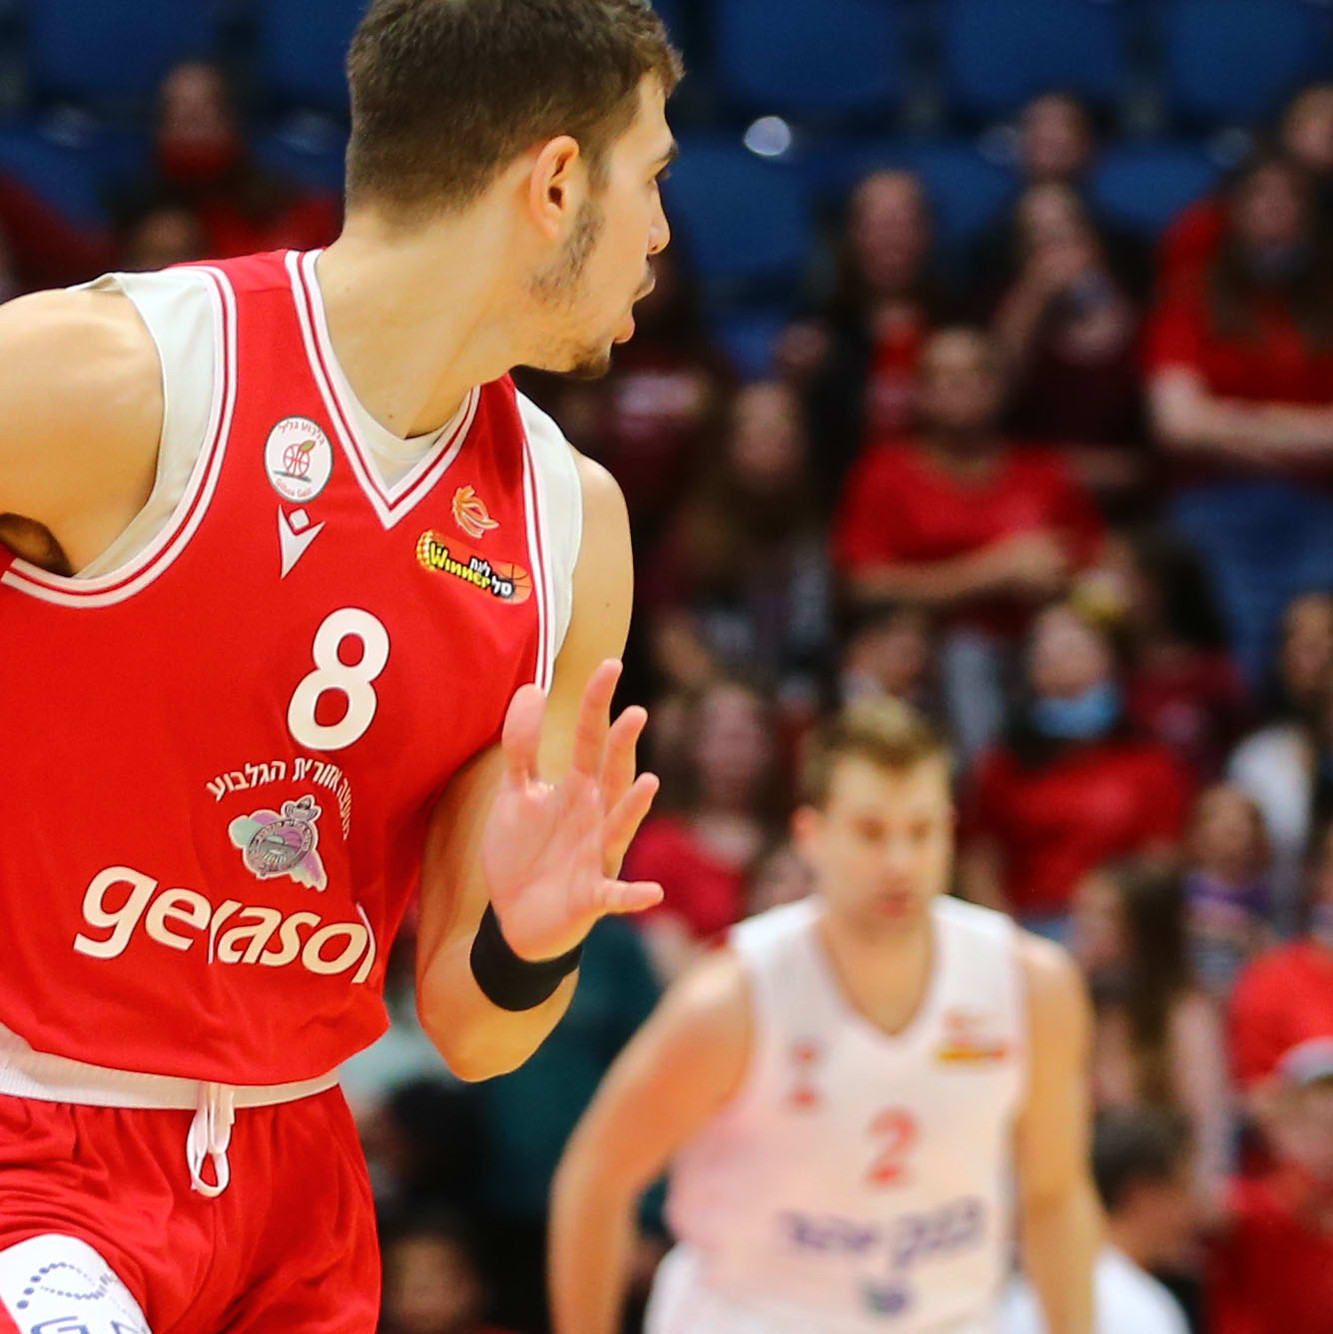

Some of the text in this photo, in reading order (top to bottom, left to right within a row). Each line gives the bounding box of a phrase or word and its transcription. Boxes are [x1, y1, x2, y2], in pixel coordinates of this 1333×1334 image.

[429, 541, 491, 589] Winner
[287, 606, 390, 750] 8
[206, 760, 287, 802] הגלבוע
[868, 1106, 920, 1187] 2
